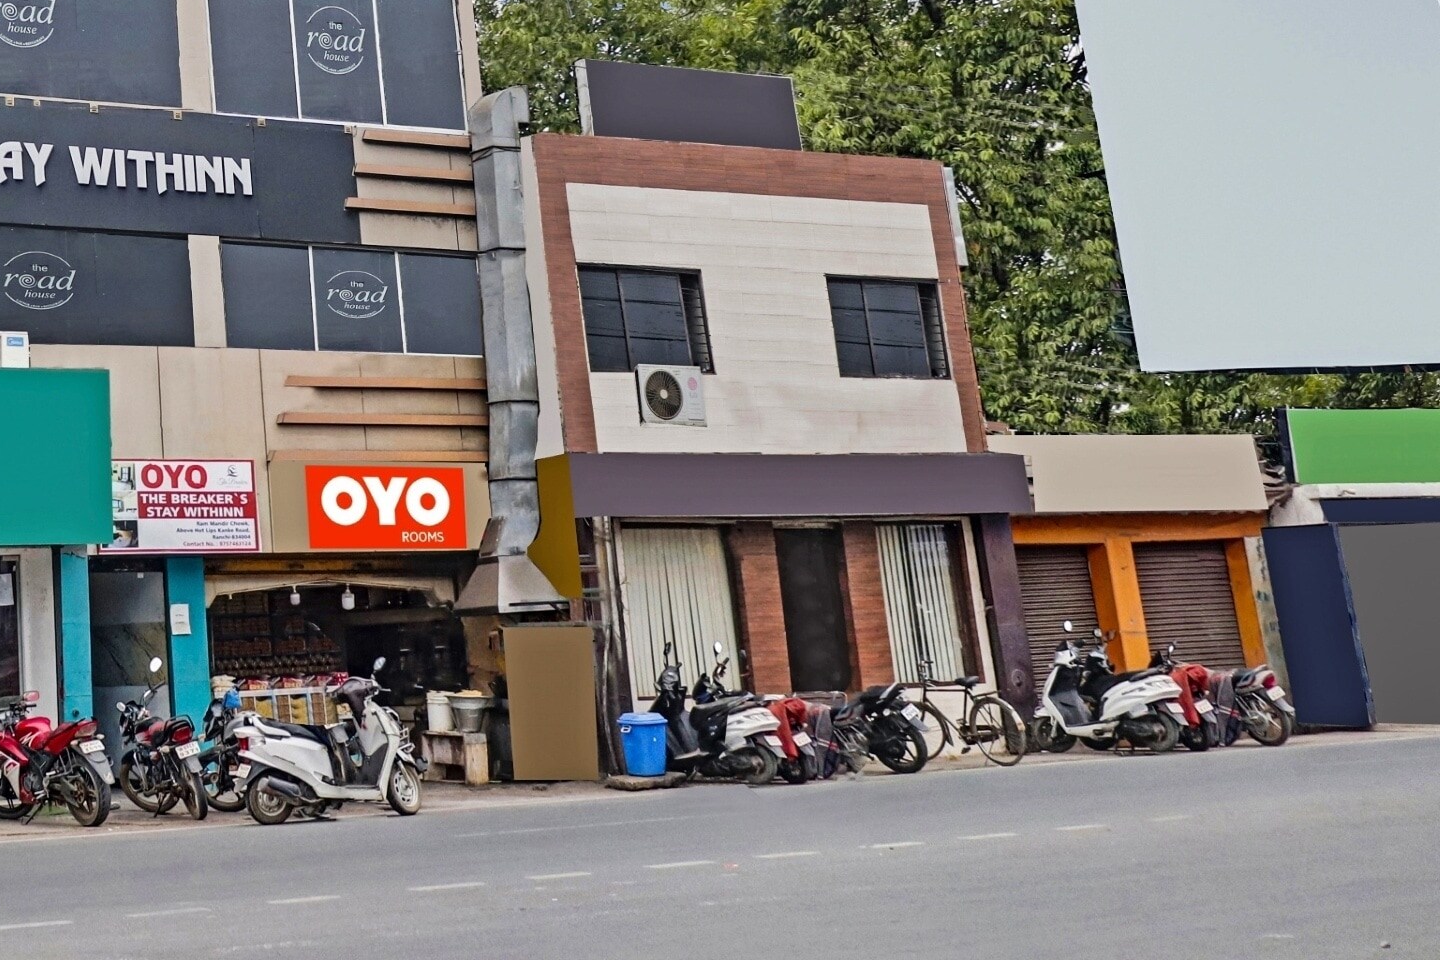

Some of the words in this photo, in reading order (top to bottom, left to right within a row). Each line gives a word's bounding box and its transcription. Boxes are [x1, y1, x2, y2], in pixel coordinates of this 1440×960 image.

[7, 21, 37, 34] house
[328, 21, 342, 30] the
[306, 28, 365, 52] road
[323, 50, 349, 62] house
[68, 145, 253, 195] WITHINN
[32, 263, 48, 272] the
[3, 269, 76, 290] road
[350, 280, 364, 288] the
[24, 289, 56, 299] house
[326, 285, 388, 303] road
[343, 301, 371, 310] house
[140, 463, 208, 489] OYO
[140, 493, 167, 504] THE
[321, 475, 450, 526] OYO
[146, 506, 180, 517] STAY
[184, 506, 244, 517] WITHINN
[401, 531, 445, 542] ROOMS
